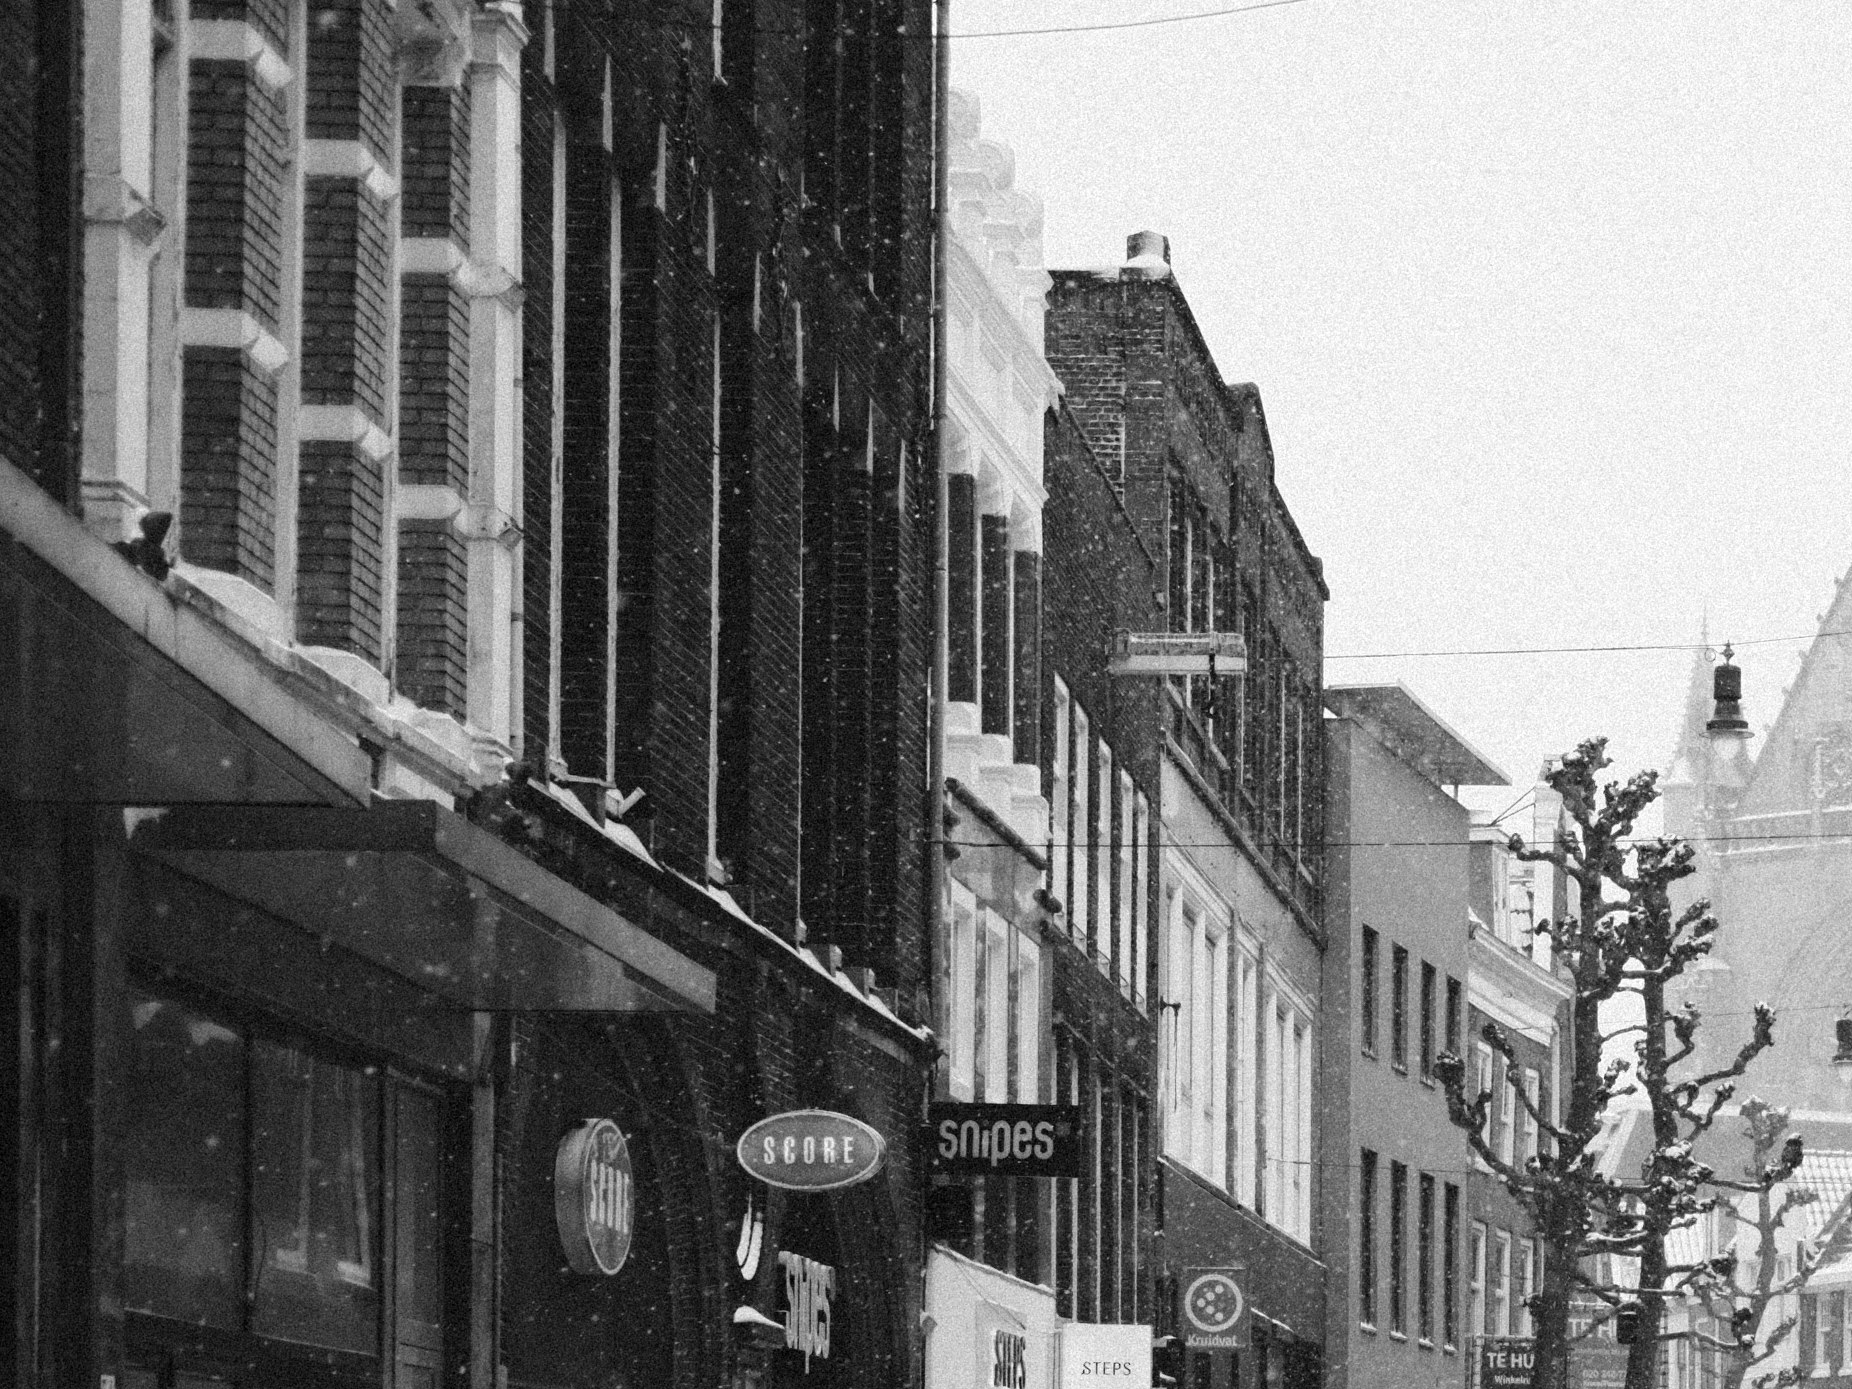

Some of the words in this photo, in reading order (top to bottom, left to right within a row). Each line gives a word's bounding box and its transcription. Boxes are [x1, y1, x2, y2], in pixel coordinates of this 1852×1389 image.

[763, 1136, 855, 1165] SCORE
[938, 1120, 1054, 1167] snipes
[1188, 1333, 1238, 1348] Kruidvat
[1081, 1361, 1132, 1376] STEPS
[1487, 1353, 1507, 1368] TE
[1511, 1353, 1535, 1369] HU
